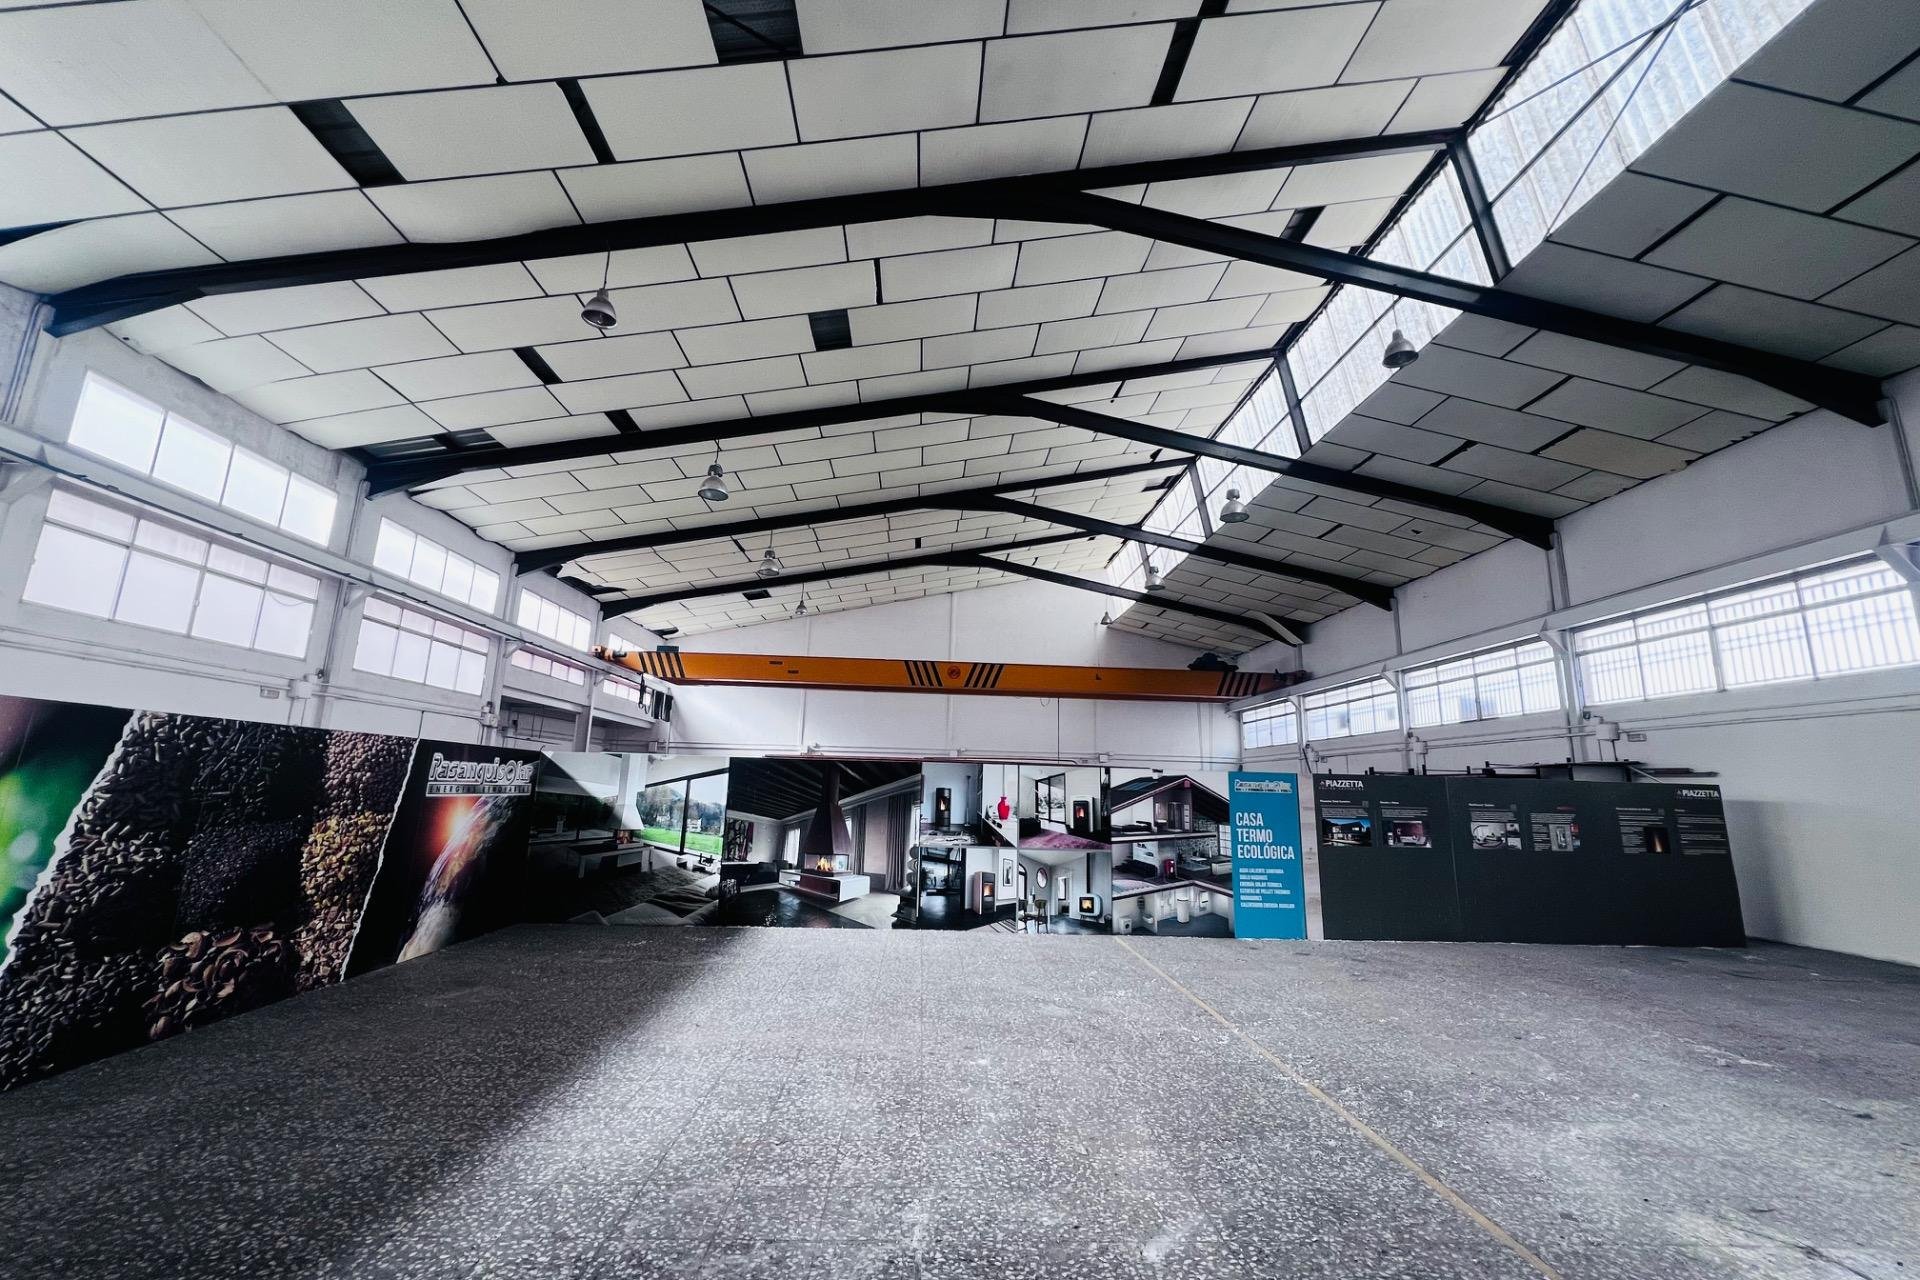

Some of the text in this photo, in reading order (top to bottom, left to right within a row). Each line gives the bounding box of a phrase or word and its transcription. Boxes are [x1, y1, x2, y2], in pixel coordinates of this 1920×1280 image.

[1682, 789, 1720, 798] PIAZZETTA
[1235, 812, 1264, 826] CASA
[1236, 828, 1273, 843] TERMO
[1237, 843, 1295, 860] ECOLÓGICA
